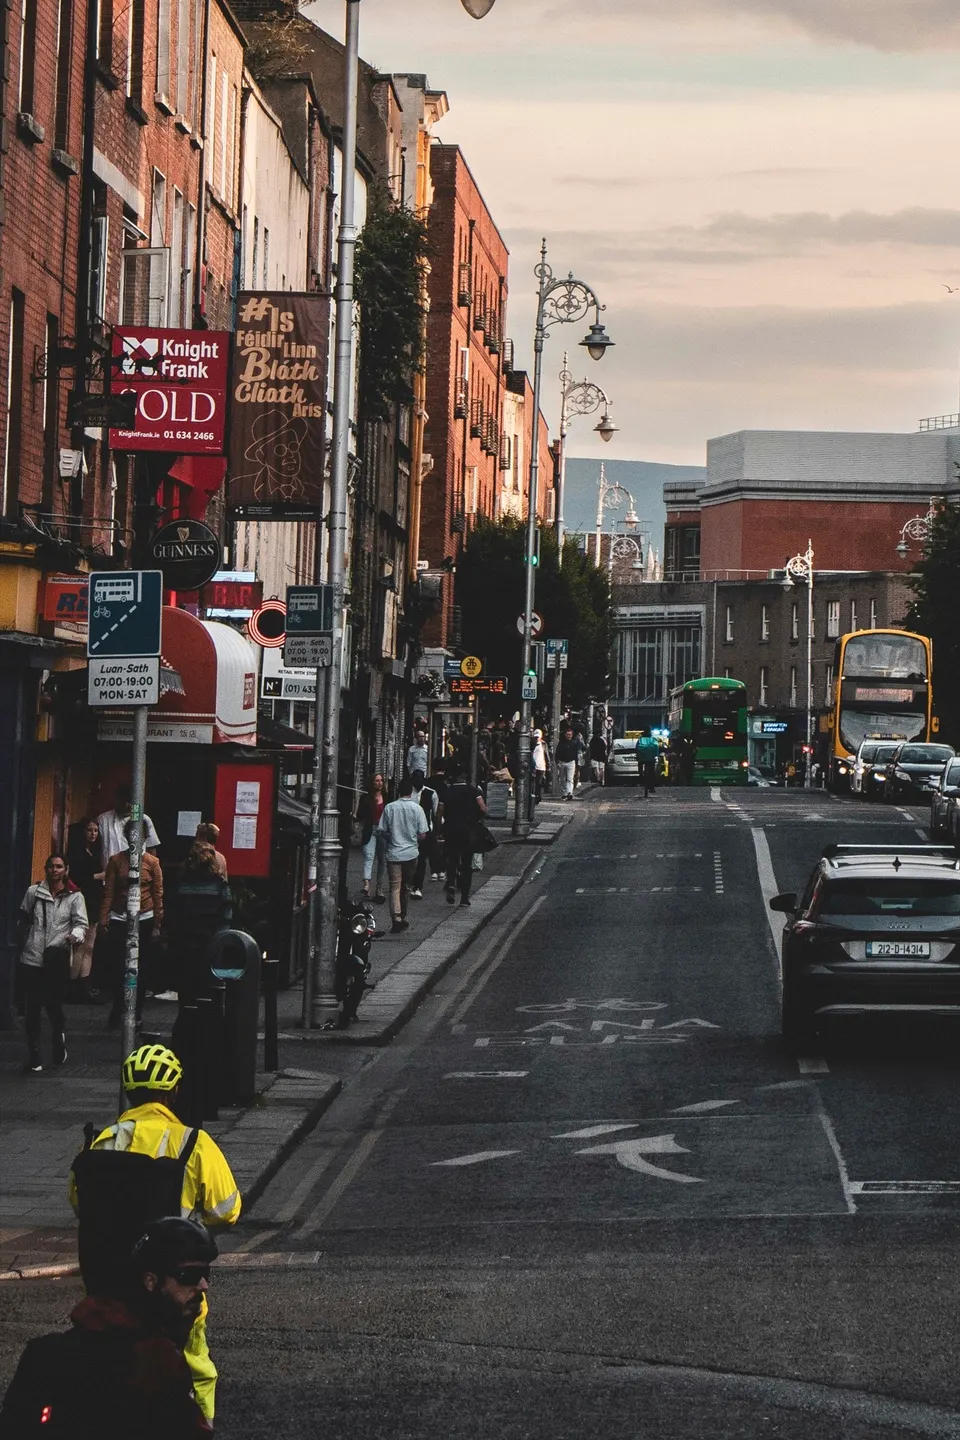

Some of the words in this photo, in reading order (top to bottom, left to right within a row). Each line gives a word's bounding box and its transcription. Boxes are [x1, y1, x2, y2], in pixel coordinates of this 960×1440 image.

[162, 339, 219, 362] Knight
[236, 330, 284, 348] Féidir
[283, 342, 317, 358] Linn
[161, 360, 209, 378] Frank
[239, 347, 319, 382] Bláth
[234, 381, 307, 403] Cliath
[121, 388, 216, 422] OLD
[292, 402, 322, 418] Arís
[118, 430, 160, 439] KnightFrank.ie
[163, 430, 174, 439] 01
[176, 431, 192, 440] 634
[193, 431, 215, 441] 2466
[153, 544, 215, 559] GUINNESS
[214, 585, 253, 606] BAR
[100, 663, 149, 674] Luan-Sath
[93, 676, 153, 687] 07:00-19:00
[285, 684, 300, 694] (01)
[99, 689, 148, 700] MON-SAT
[877, 944, 924, 954] 212-D-14314
